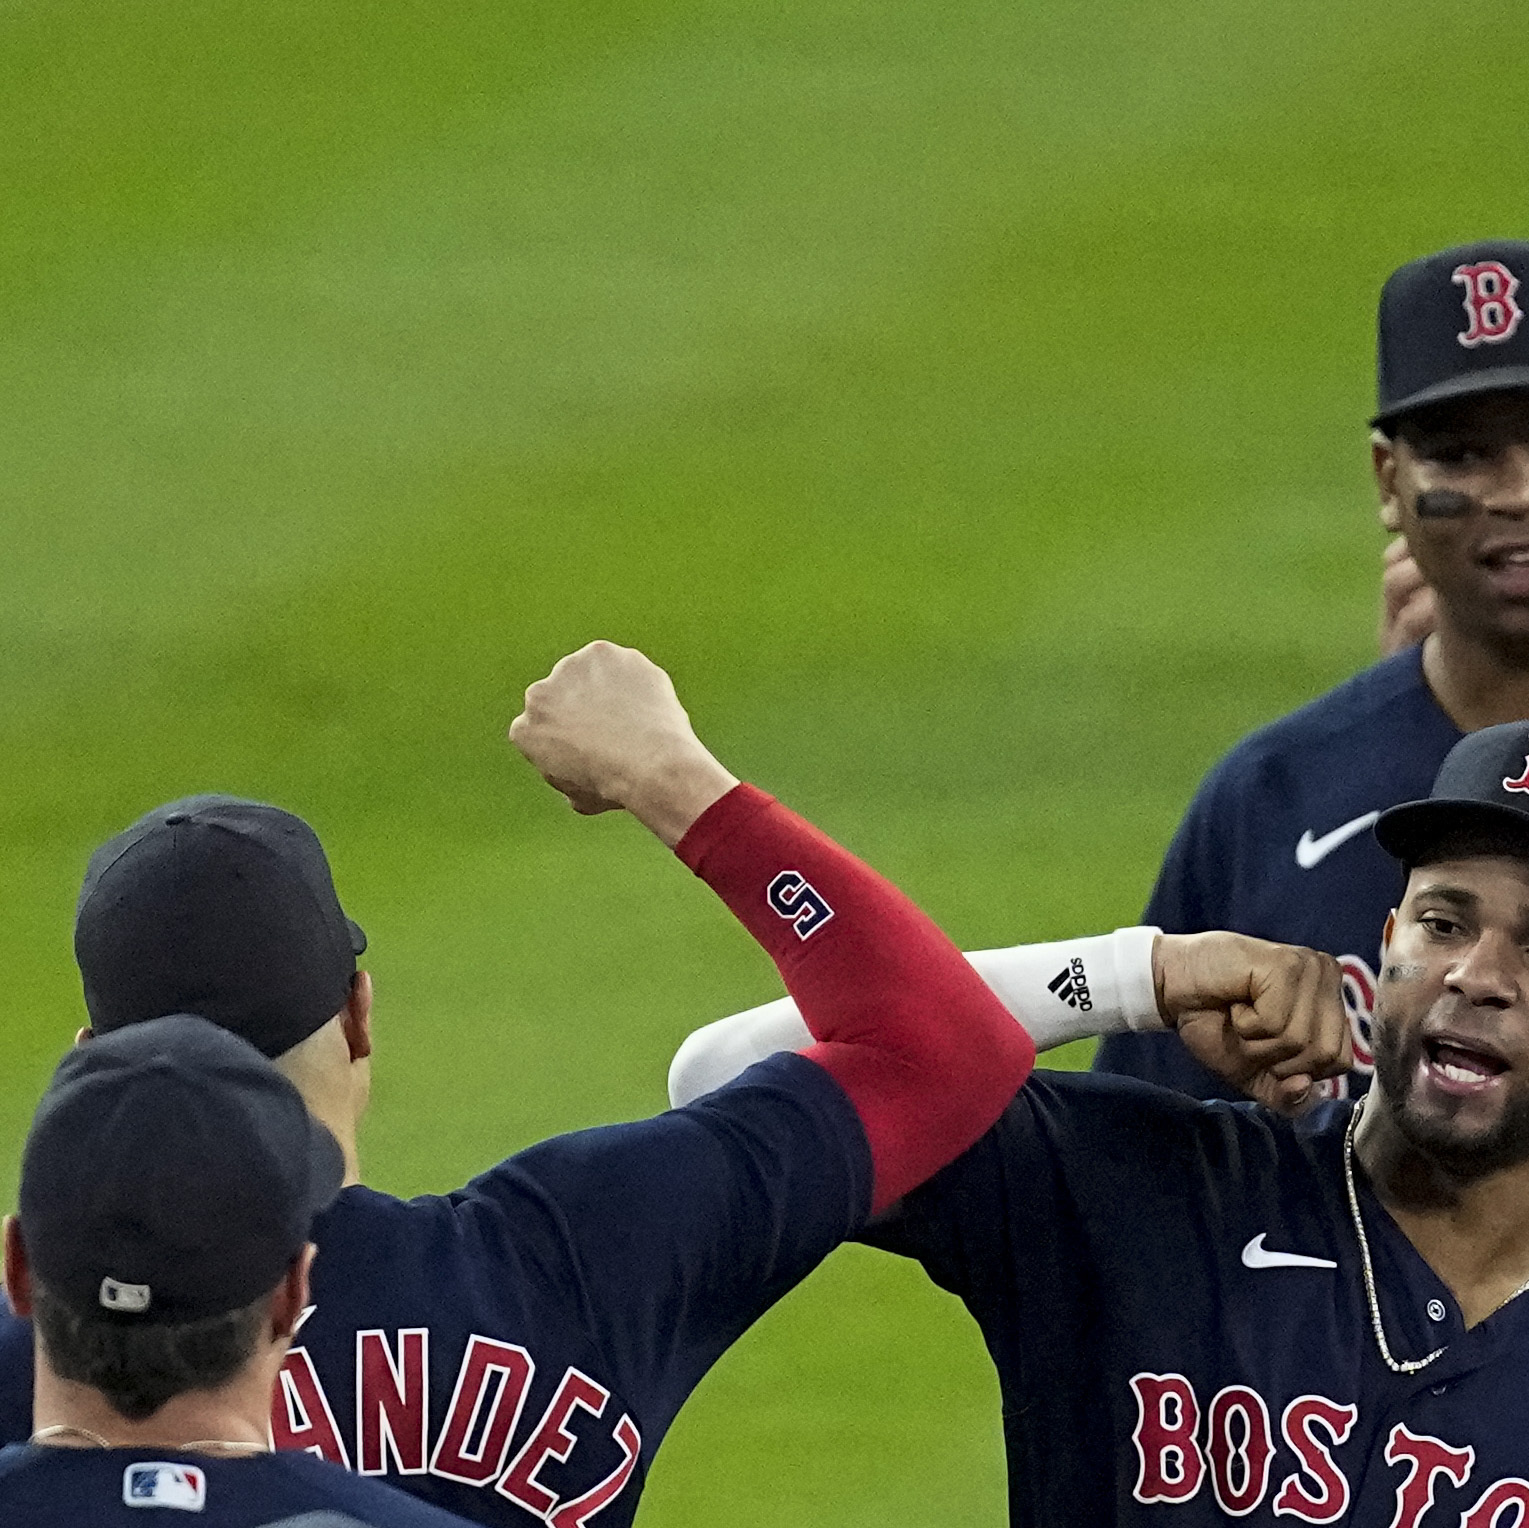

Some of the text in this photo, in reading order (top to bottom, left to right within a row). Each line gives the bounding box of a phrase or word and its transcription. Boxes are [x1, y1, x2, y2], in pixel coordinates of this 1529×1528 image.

[1452, 262, 1523, 349] B
[767, 870, 834, 941] 5
[1070, 957, 1093, 1012] adidas
